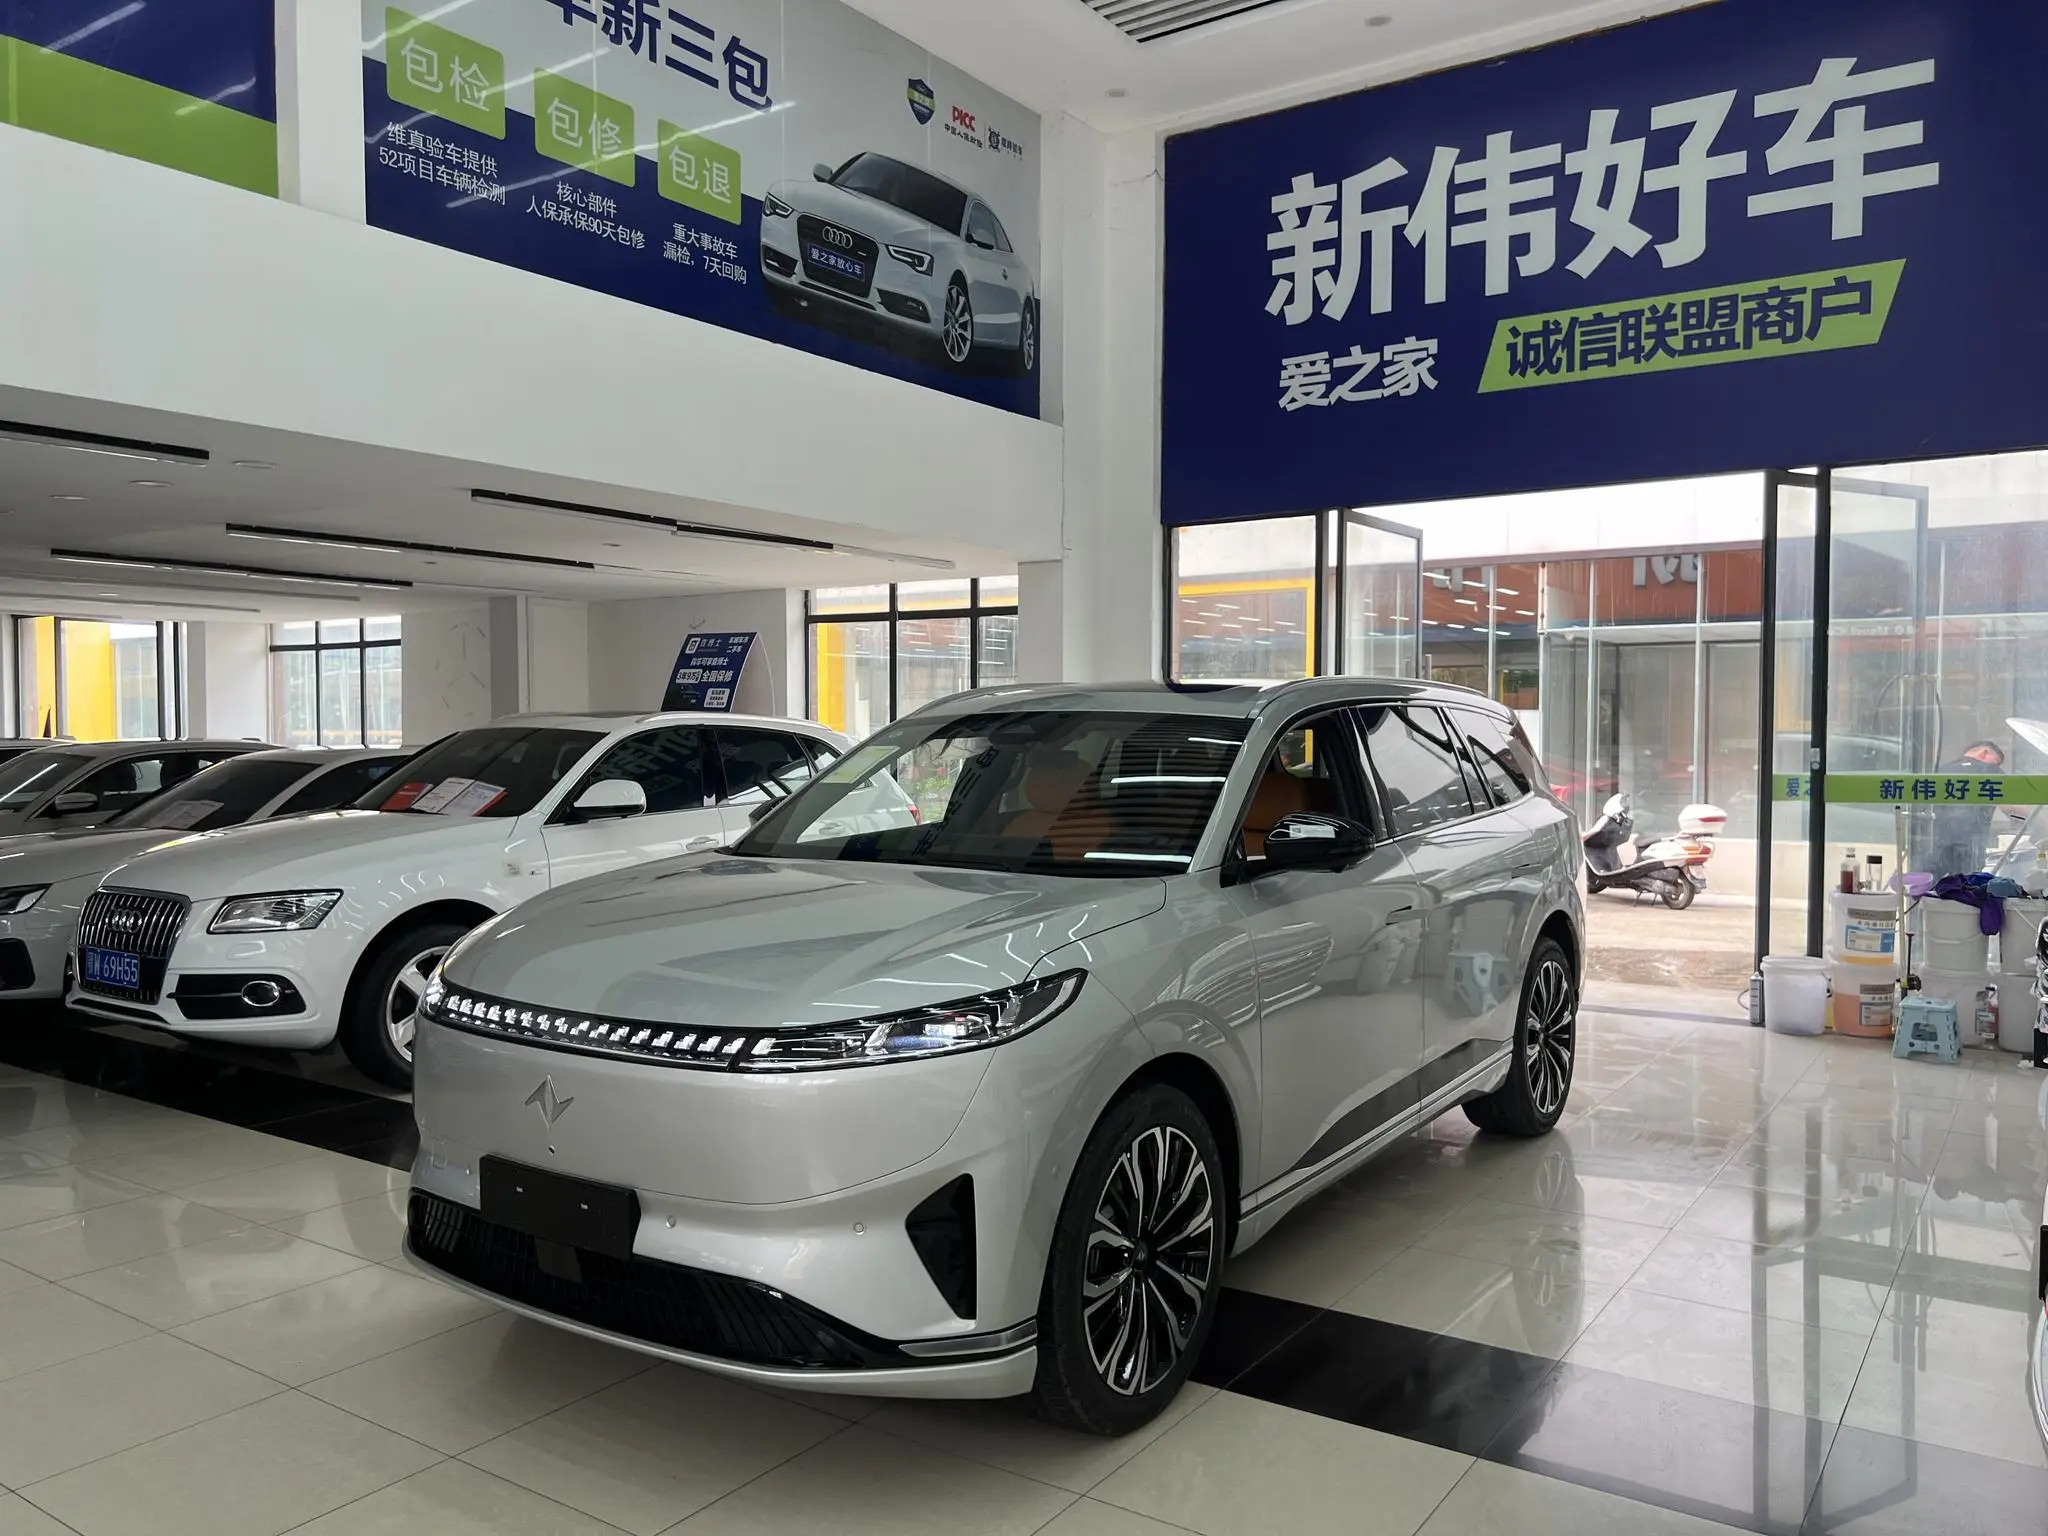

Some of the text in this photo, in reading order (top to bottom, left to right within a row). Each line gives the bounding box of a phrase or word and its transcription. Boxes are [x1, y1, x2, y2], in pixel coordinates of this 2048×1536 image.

[400, 37, 491, 113] 包检
[546, 97, 623, 159] 包修
[952, 105, 976, 133] PICC
[378, 146, 507, 206] 52项目车辆检测
[386, 121, 499, 179] 维真验车提供
[667, 145, 733, 205] 包退
[556, 180, 619, 219] 核心部件
[1263, 56, 1940, 326] 新伟好车
[525, 195, 647, 250] 人保承保90天包修
[672, 222, 739, 261] 重大事故车
[1505, 275, 1873, 379] 诚信联盟商户
[1276, 334, 1441, 412] 爱之家
[1879, 778, 2004, 801] 新伟好车
